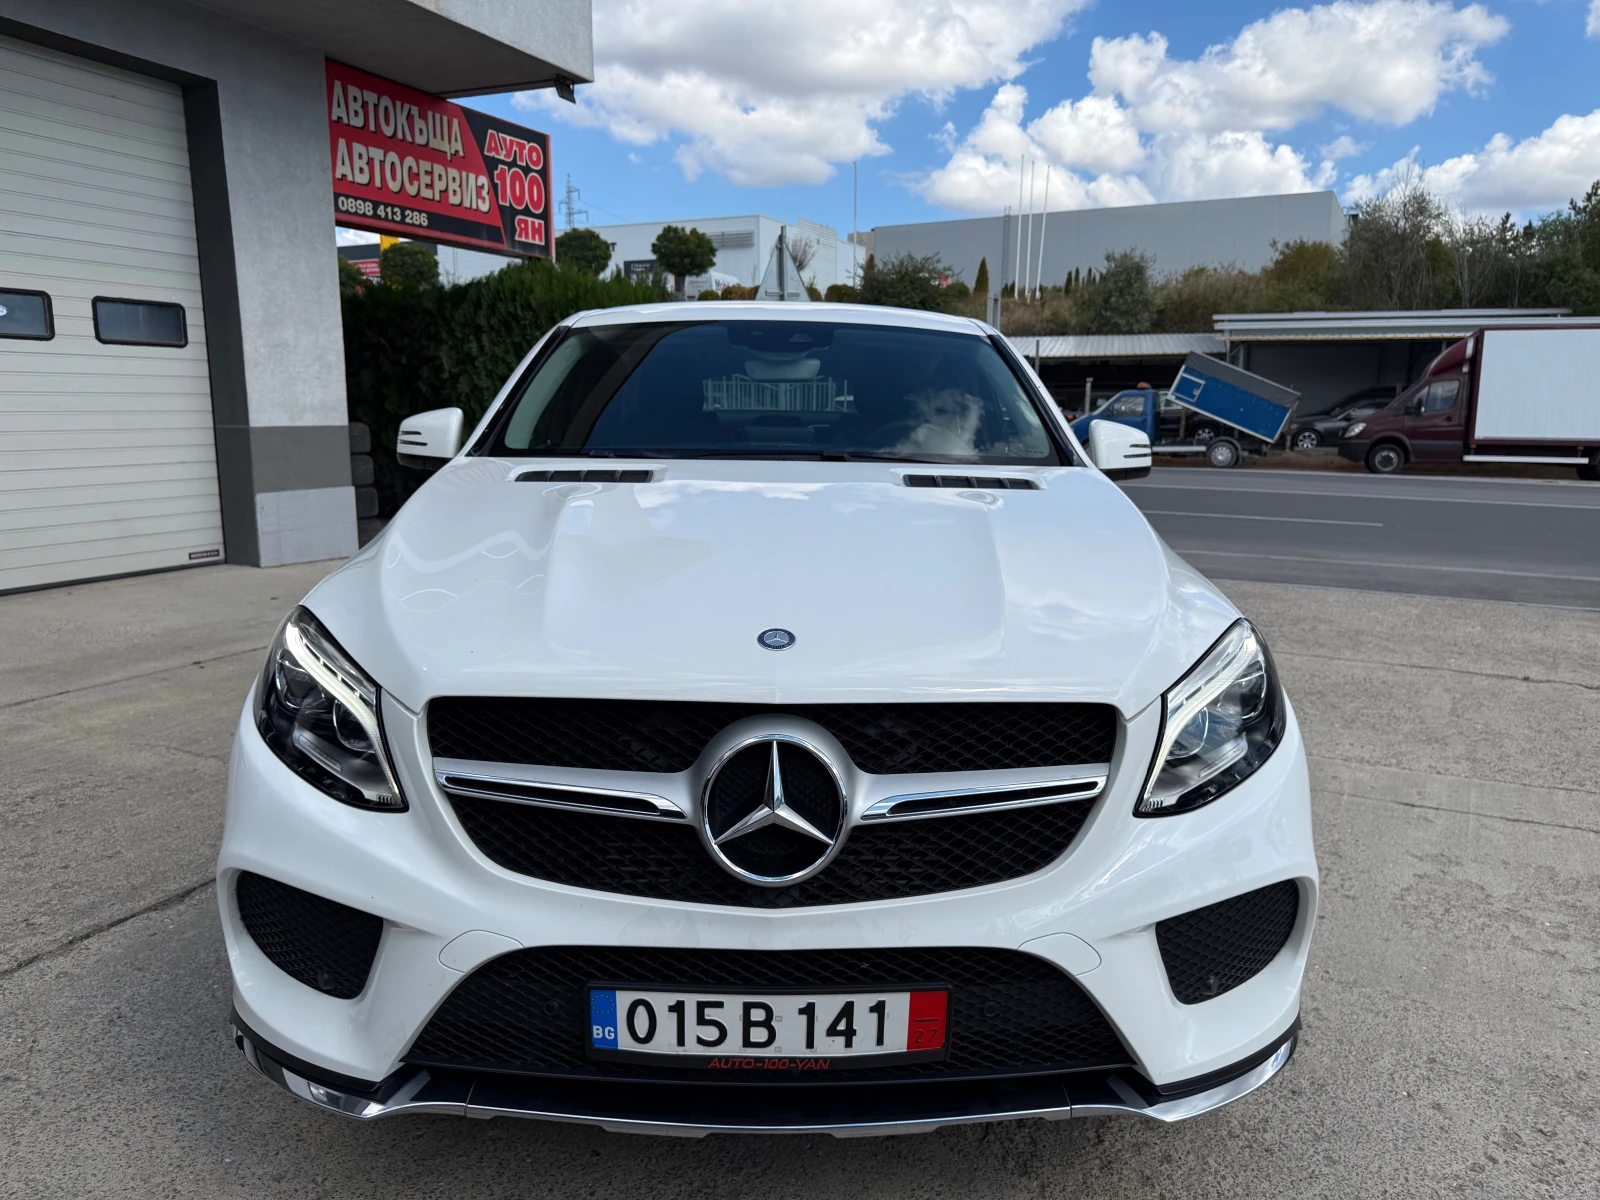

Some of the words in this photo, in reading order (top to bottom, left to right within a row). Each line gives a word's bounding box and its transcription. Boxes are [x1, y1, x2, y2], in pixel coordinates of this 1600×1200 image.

[331, 80, 465, 160] АВТОКЪЩА
[485, 129, 543, 170] АУТО
[335, 138, 491, 213] АВТОСЕРВИЗ
[494, 165, 545, 214] 100
[338, 196, 374, 216] 0898
[377, 203, 402, 221] 413
[405, 210, 429, 226] 286
[515, 215, 545, 246] ЯН
[592, 1025, 615, 1040] BG
[914, 1029, 938, 1044] 27
[707, 1057, 831, 1071] AUTO-100-YAN
